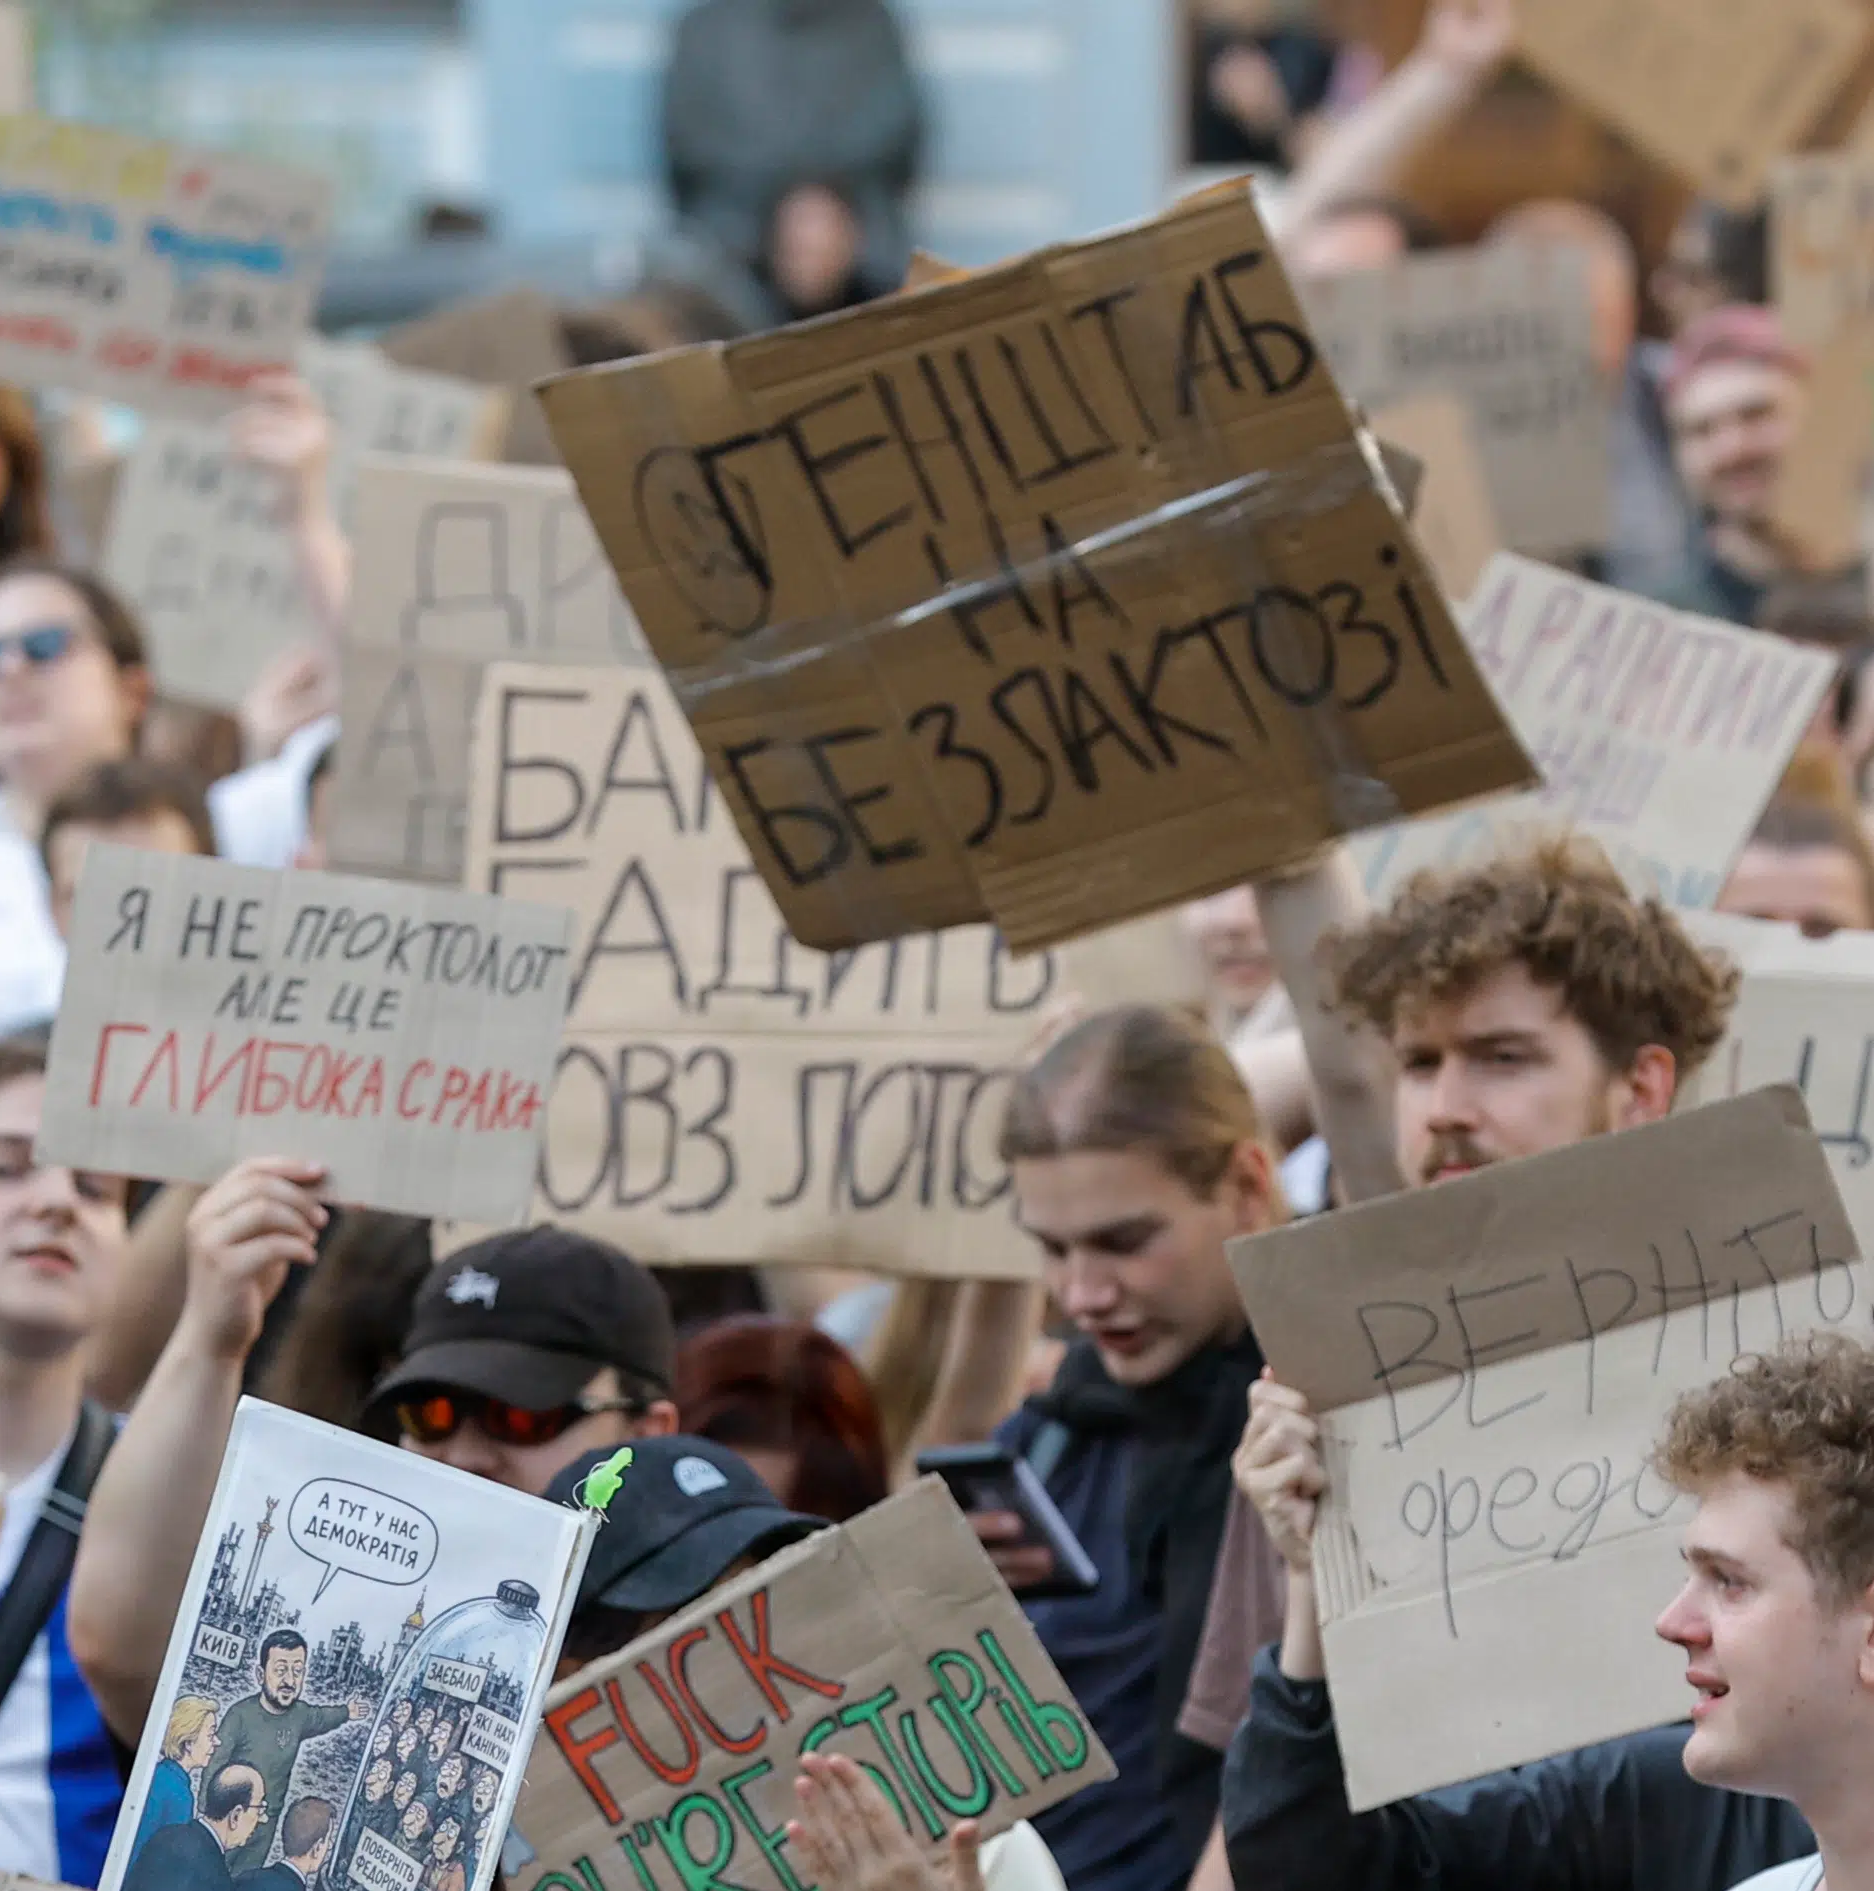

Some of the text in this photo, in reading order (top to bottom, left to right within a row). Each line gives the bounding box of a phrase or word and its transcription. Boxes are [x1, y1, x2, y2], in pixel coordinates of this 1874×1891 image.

[691, 248, 1318, 599] ГЕНШТАБ
[923, 510, 1136, 665] НА
[106, 885, 148, 954] Я
[178, 893, 262, 965] НЕ
[325, 985, 399, 1034] ЦЕ
[89, 1022, 543, 1134] ГЛИБОКА СРАКА
[304, 1515, 419, 1570] ДЕМОКРАТІЯ
[318, 1492, 419, 1540] А ТУТ У НАС
[199, 1631, 240, 1661] КИЇВ
[427, 1661, 482, 1695] ЗАЄБАЛО
[471, 1710, 494, 1733] ЯКІ
[542, 1586, 848, 1828] FUCK
[361, 1833, 417, 1884] ПОВЕРНІТЬ
